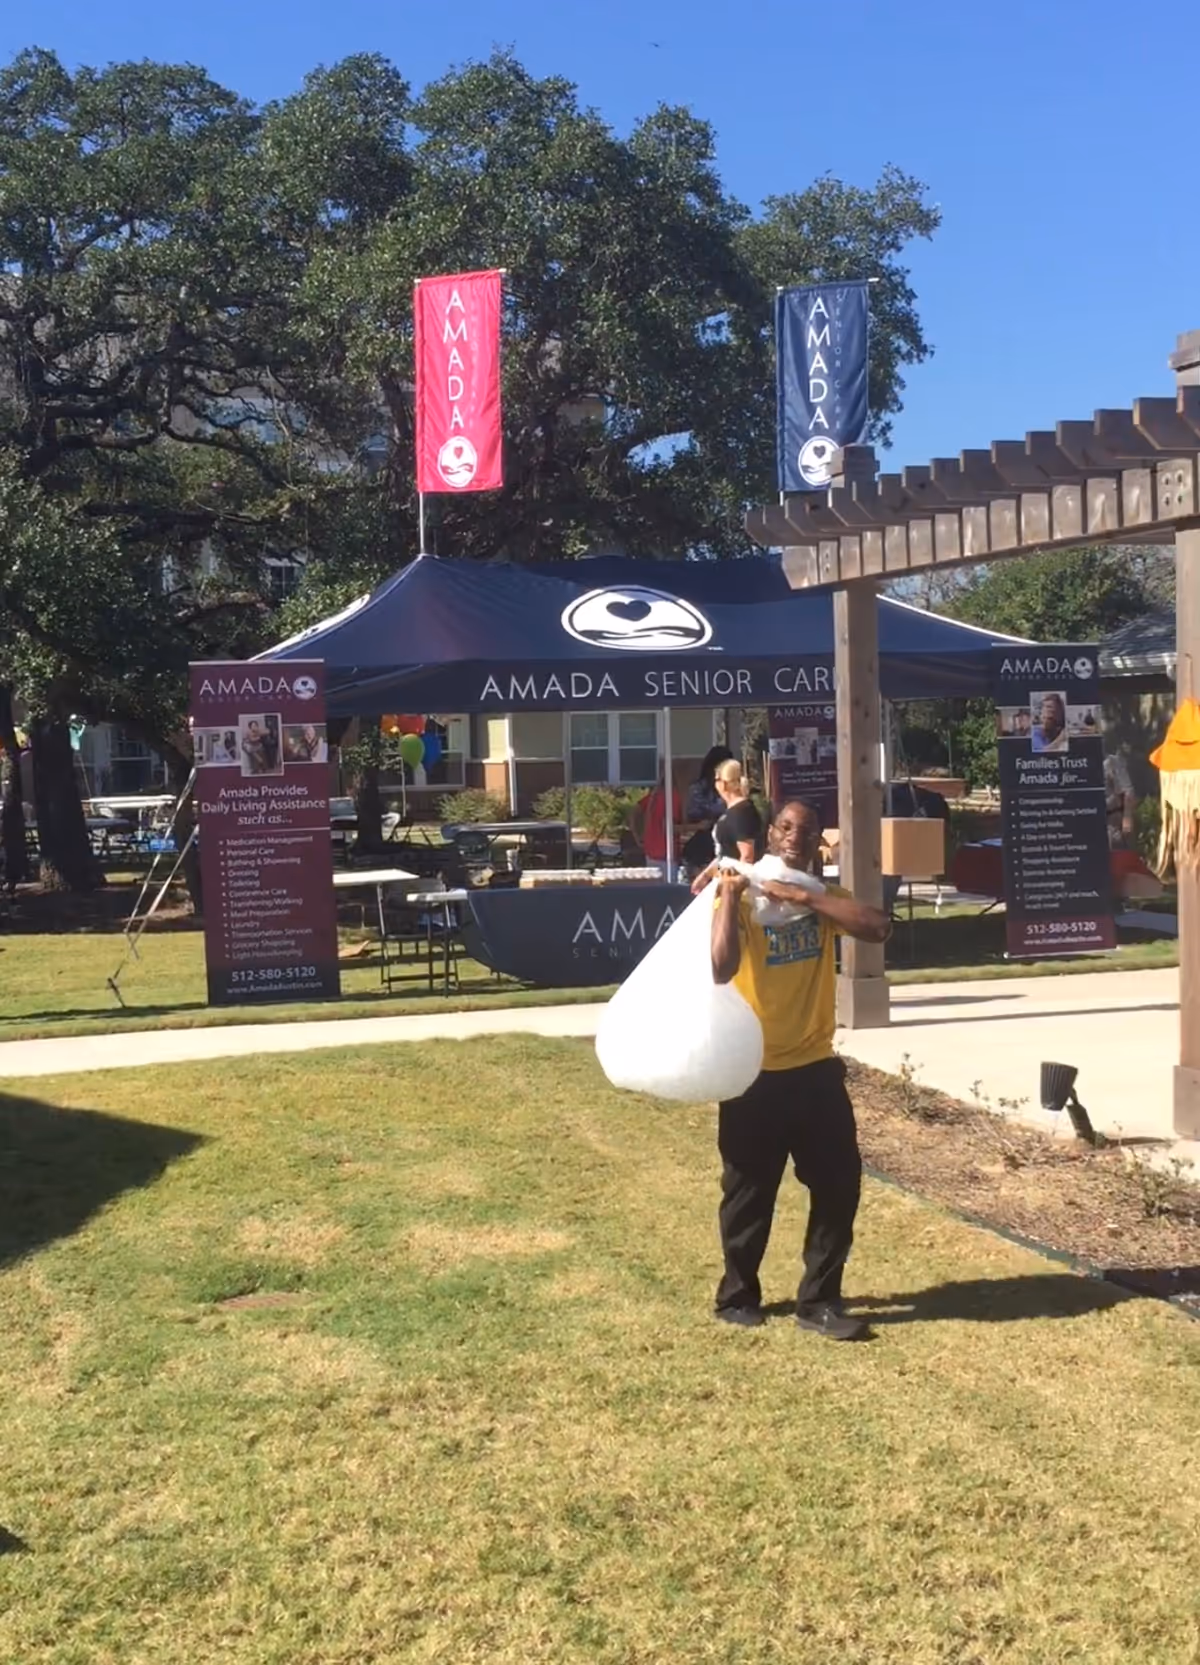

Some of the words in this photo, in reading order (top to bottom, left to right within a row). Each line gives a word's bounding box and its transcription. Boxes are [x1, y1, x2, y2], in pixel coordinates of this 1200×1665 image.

[443, 290, 467, 430] AMADA
[808, 297, 830, 430] AMADA
[1000, 657, 1072, 673] AMADA
[199, 676, 291, 695] AMADA
[480, 673, 620, 701] AMADA
[645, 669, 753, 697] SENIOR
[775, 706, 821, 719] AMADA
[1015, 758, 1059, 770] Families
[1060, 757, 1088, 768] Trust
[1019, 773, 1058, 785] Amada
[219, 787, 259, 798] Amada
[262, 785, 308, 796] Provides
[202, 801, 230, 814] Daily
[233, 801, 267, 813] Living
[269, 798, 326, 810] Assistance
[237, 813, 266, 826] such
[1026, 921, 1096, 935] 512-580-5120
[232, 966, 316, 982] 512-580-5120
